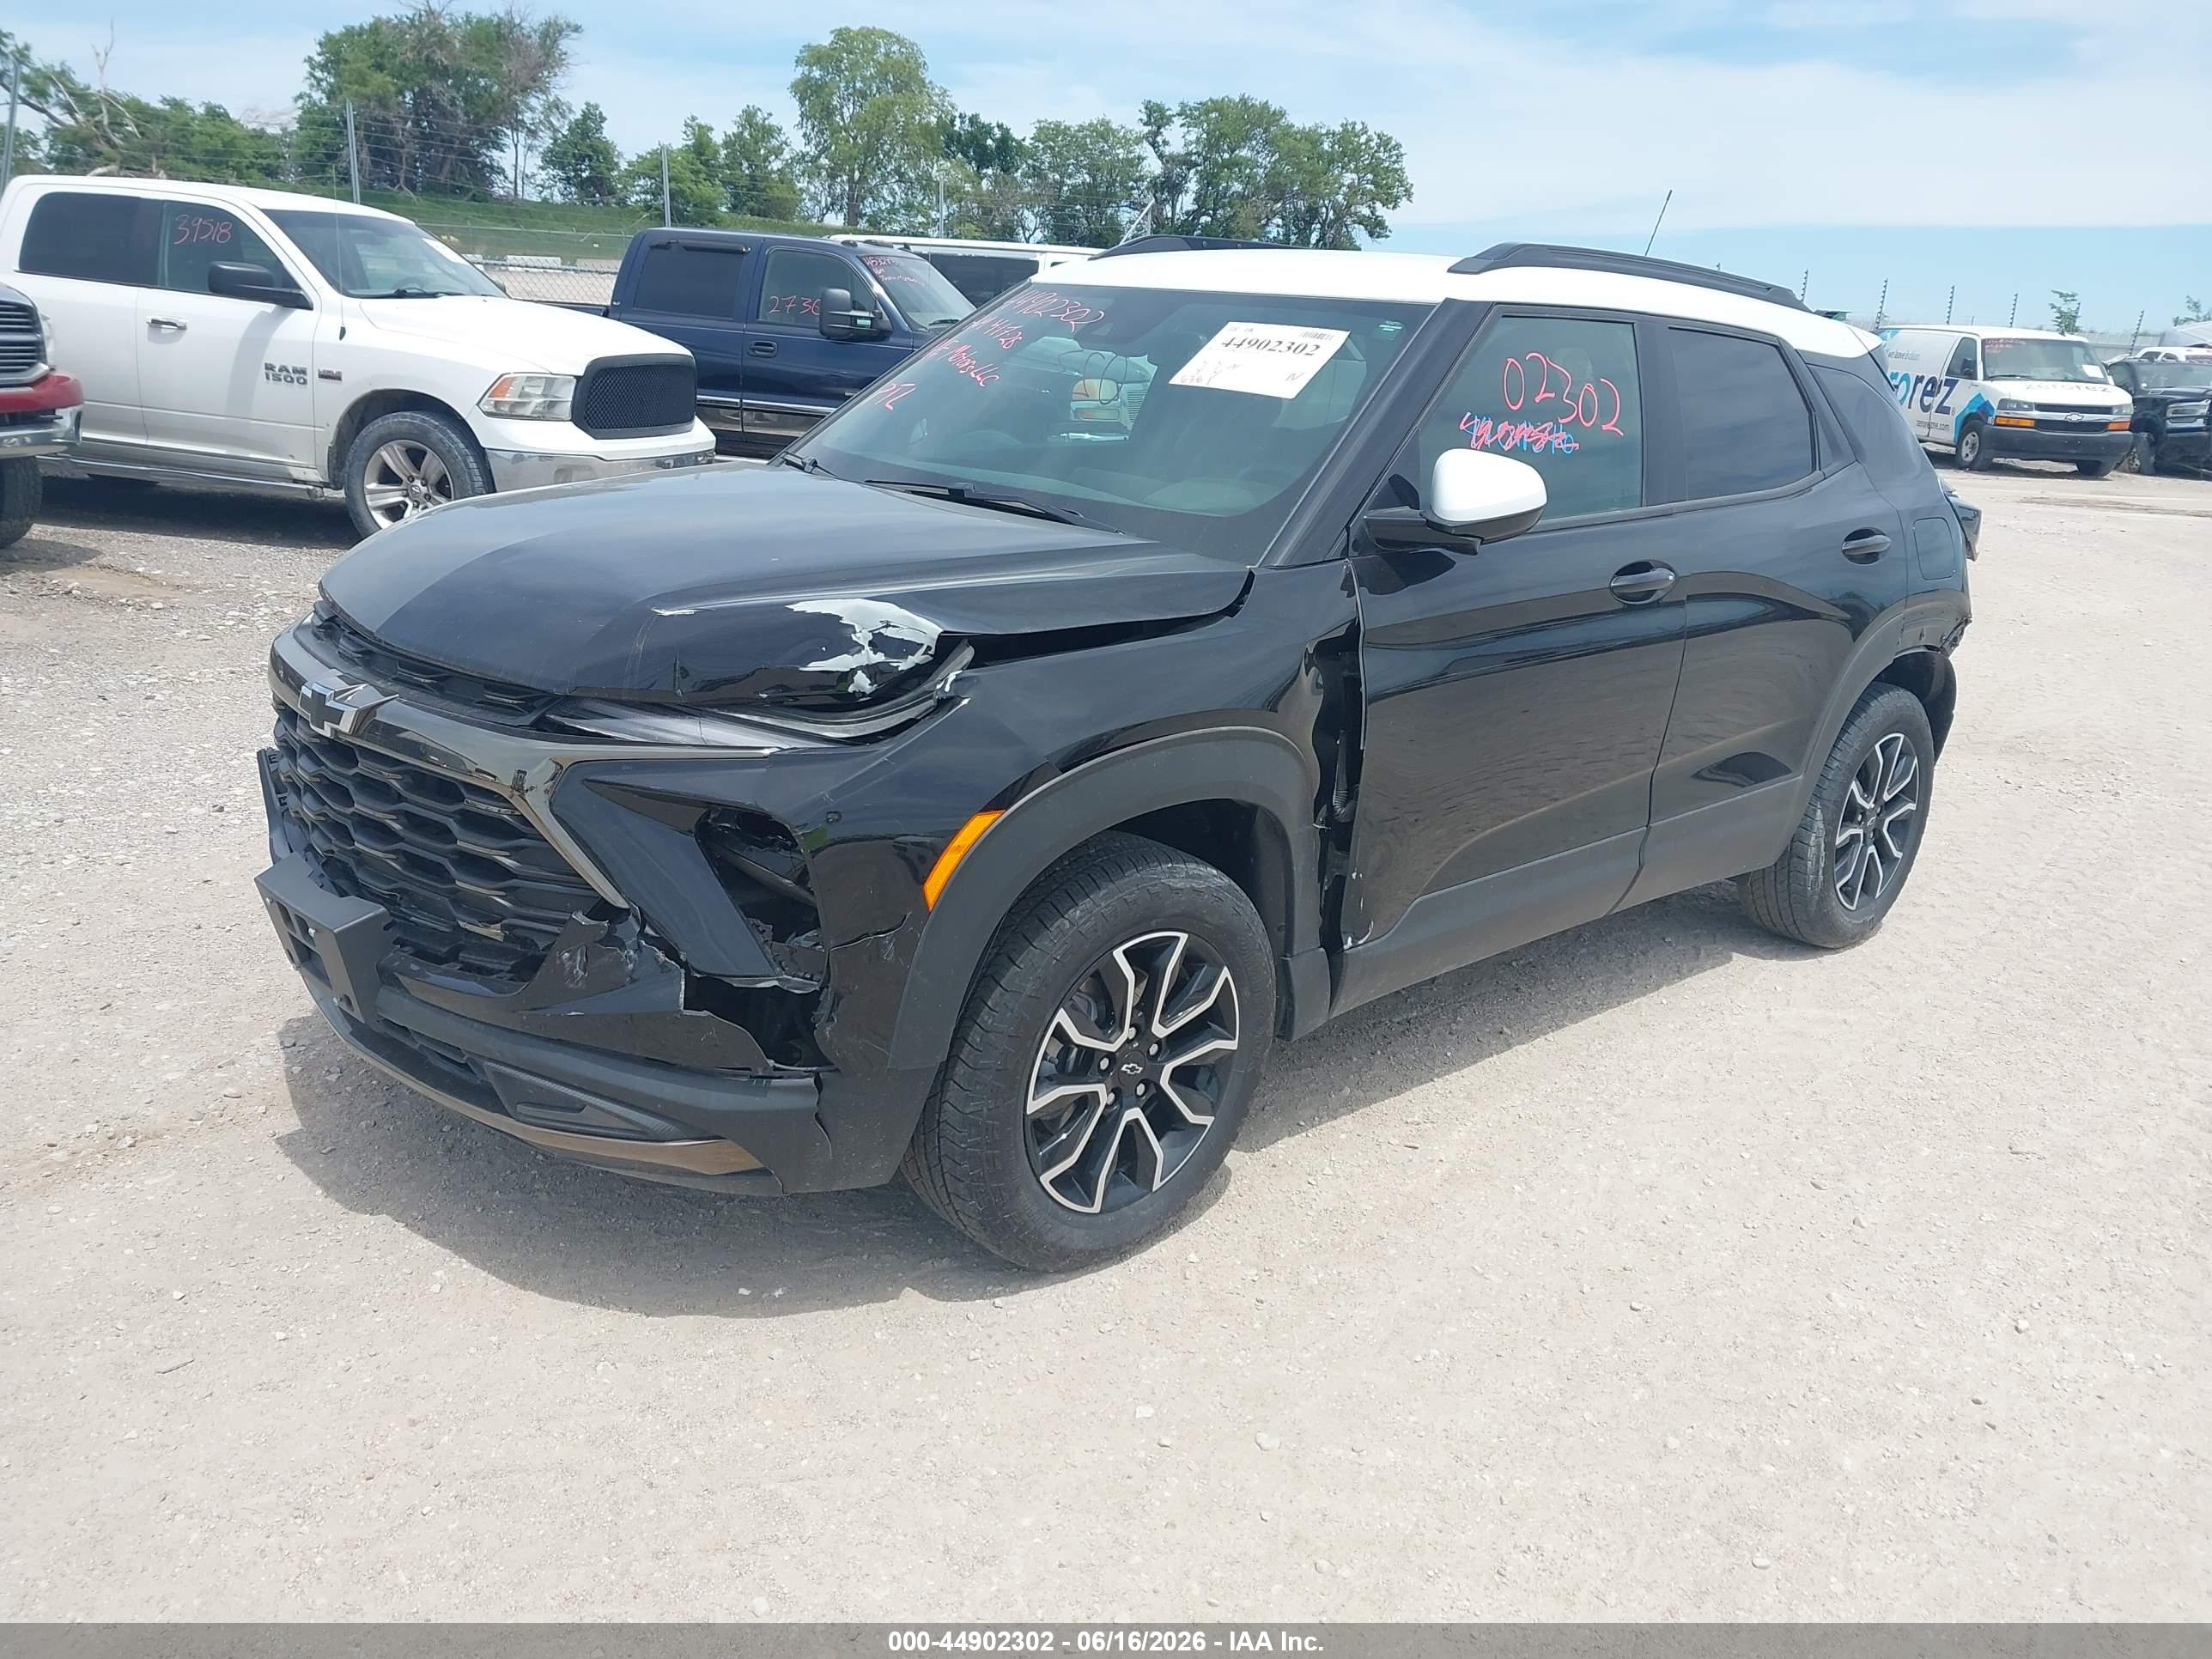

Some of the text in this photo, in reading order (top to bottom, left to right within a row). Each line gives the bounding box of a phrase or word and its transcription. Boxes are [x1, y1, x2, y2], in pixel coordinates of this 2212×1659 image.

[173, 214, 233, 245] 39518
[1221, 337, 1321, 356] 44902302
[264, 362, 307, 376] RAM
[264, 372, 307, 385] 1500
[1504, 352, 1625, 437] 02302
